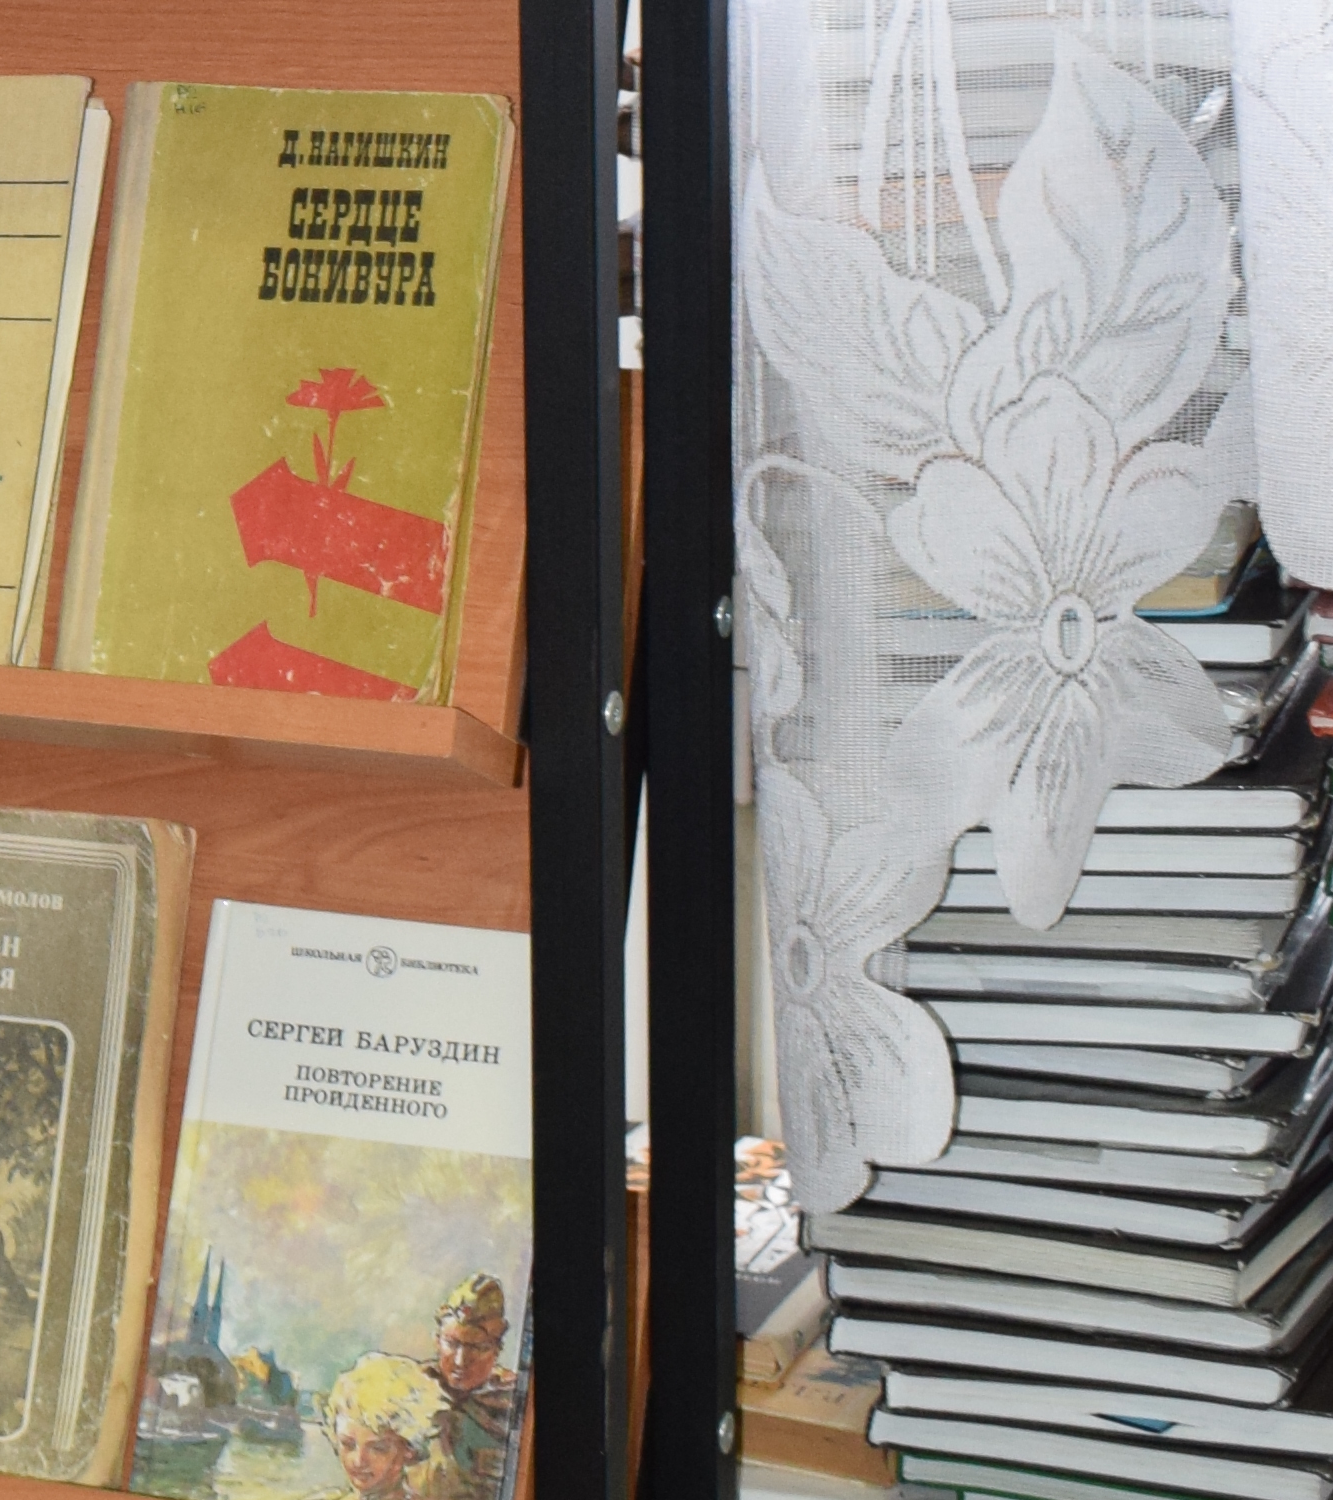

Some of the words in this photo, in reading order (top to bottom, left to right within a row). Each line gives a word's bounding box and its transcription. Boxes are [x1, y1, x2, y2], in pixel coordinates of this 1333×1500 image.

[288, 187, 424, 247] СЕРДЦЕ
[258, 246, 436, 307] БОНИВУРА
[290, 945, 363, 964] ШКОЛЬНАЯ
[399, 958, 480, 976] БИБЛИОТЕКА
[247, 1018, 343, 1048] СЕРГЕЙ
[356, 1030, 501, 1066] БАРУЗДИН
[295, 1063, 442, 1097] ПОВТОРЕНИЕ
[283, 1084, 448, 1120] ПРОЙДЕННОГО
